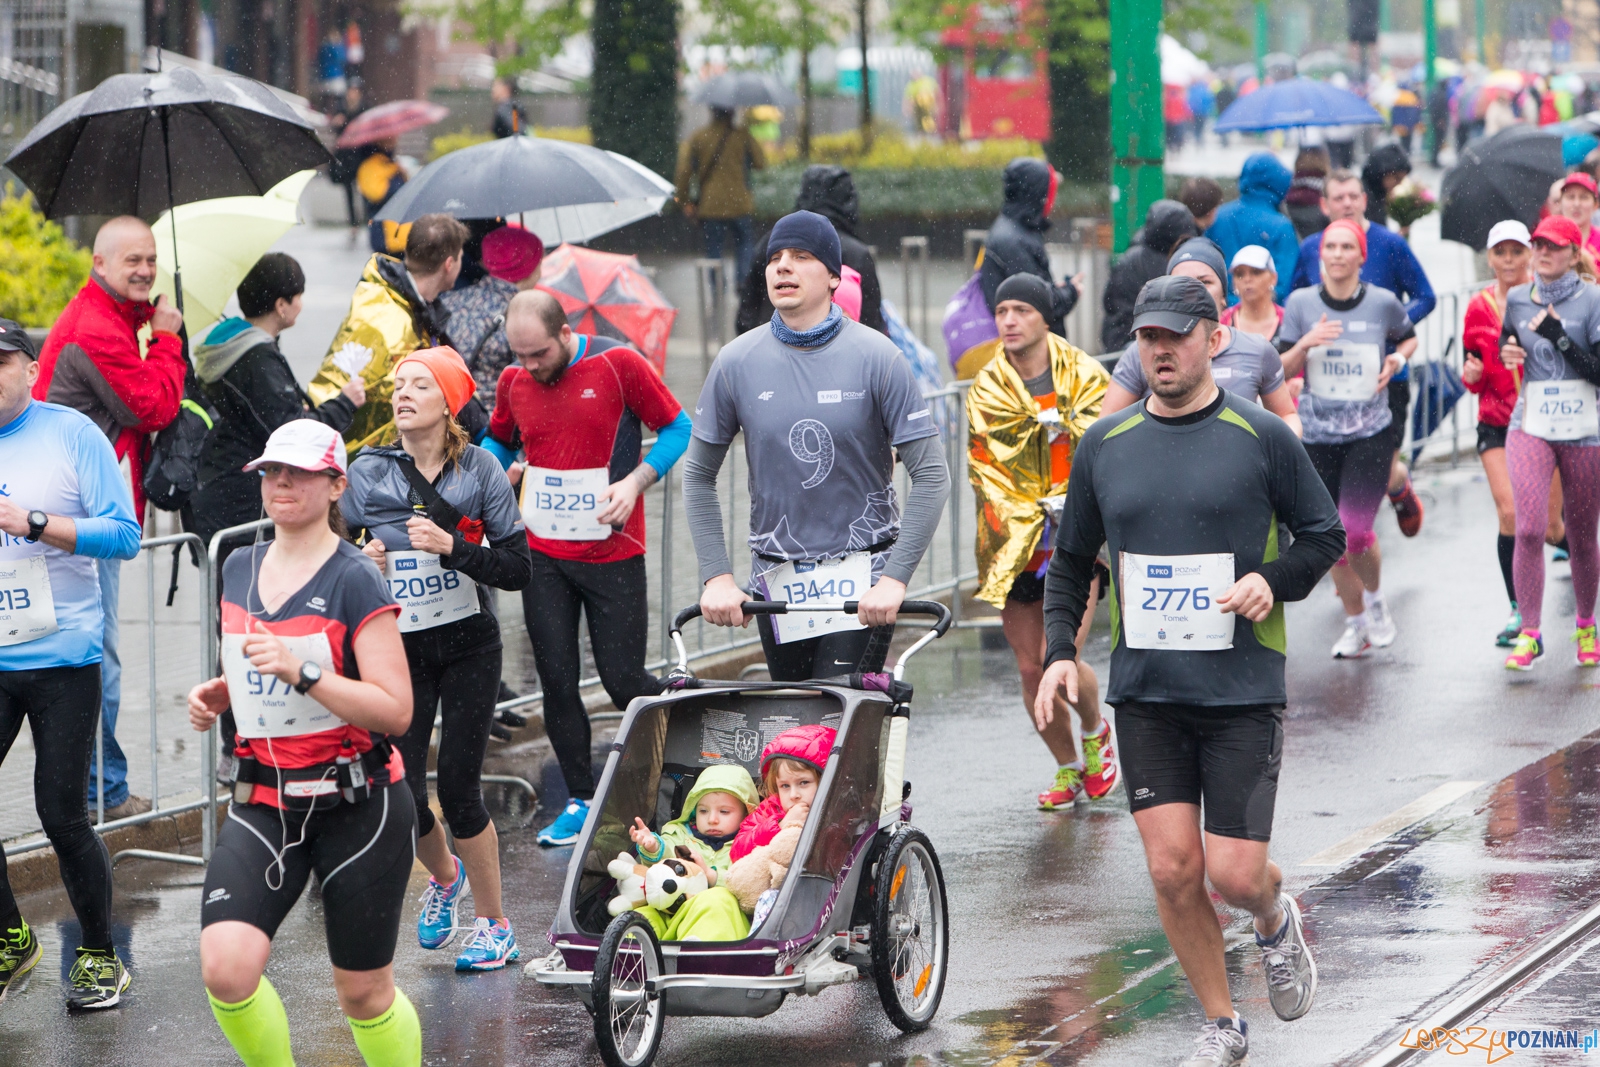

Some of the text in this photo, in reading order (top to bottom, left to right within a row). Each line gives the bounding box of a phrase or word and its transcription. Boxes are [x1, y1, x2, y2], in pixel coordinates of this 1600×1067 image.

[1322, 361, 1363, 376] 11614
[757, 391, 775, 401] 4F
[1539, 400, 1584, 415] 4762
[789, 418, 835, 490] 9
[535, 491, 596, 511] 13229
[1150, 568, 1170, 576] 9.PKO
[783, 579, 855, 604] 13440
[1142, 587, 1210, 611] 2776
[406, 596, 444, 608] Aleksandra
[1162, 614, 1189, 622] Tomek
[262, 699, 286, 707] Marta
